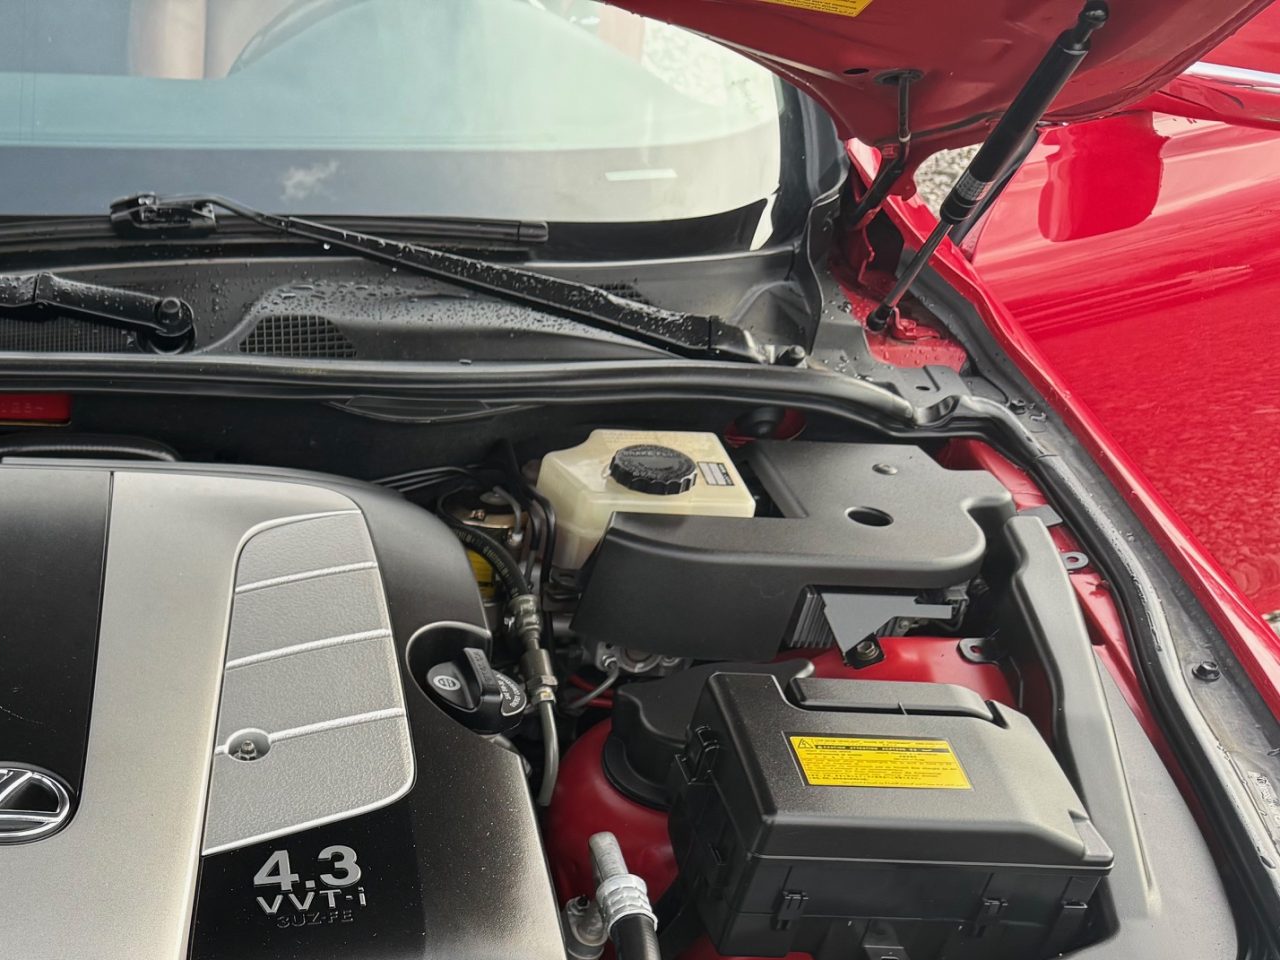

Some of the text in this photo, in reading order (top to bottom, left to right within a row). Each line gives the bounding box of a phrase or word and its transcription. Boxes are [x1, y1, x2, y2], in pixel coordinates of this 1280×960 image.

[253, 844, 362, 892] 4.3
[256, 886, 367, 915] VVT-i
[276, 909, 354, 928] 3UZ-FE
